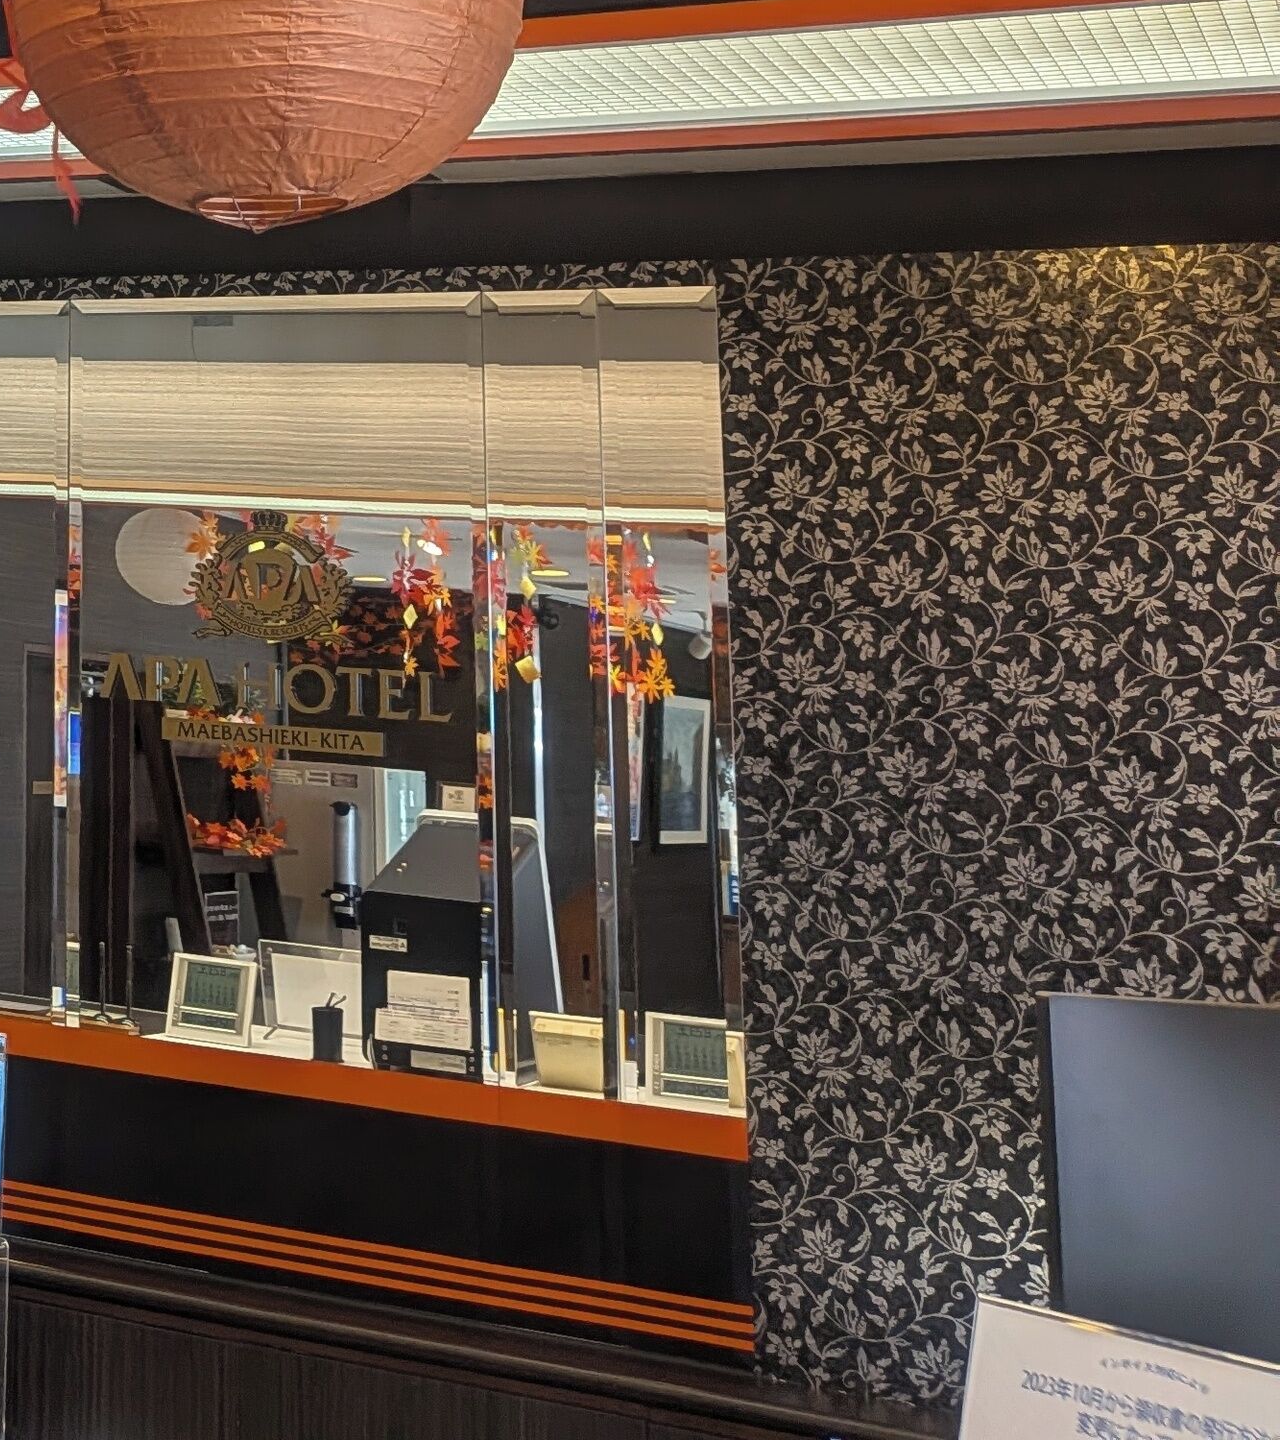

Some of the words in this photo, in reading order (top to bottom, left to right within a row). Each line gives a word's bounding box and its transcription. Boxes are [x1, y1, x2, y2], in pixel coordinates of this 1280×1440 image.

[100, 652, 222, 707] APA
[237, 660, 453, 724] HOTEL
[177, 721, 365, 751] MAEBASHIEKI-KITA
